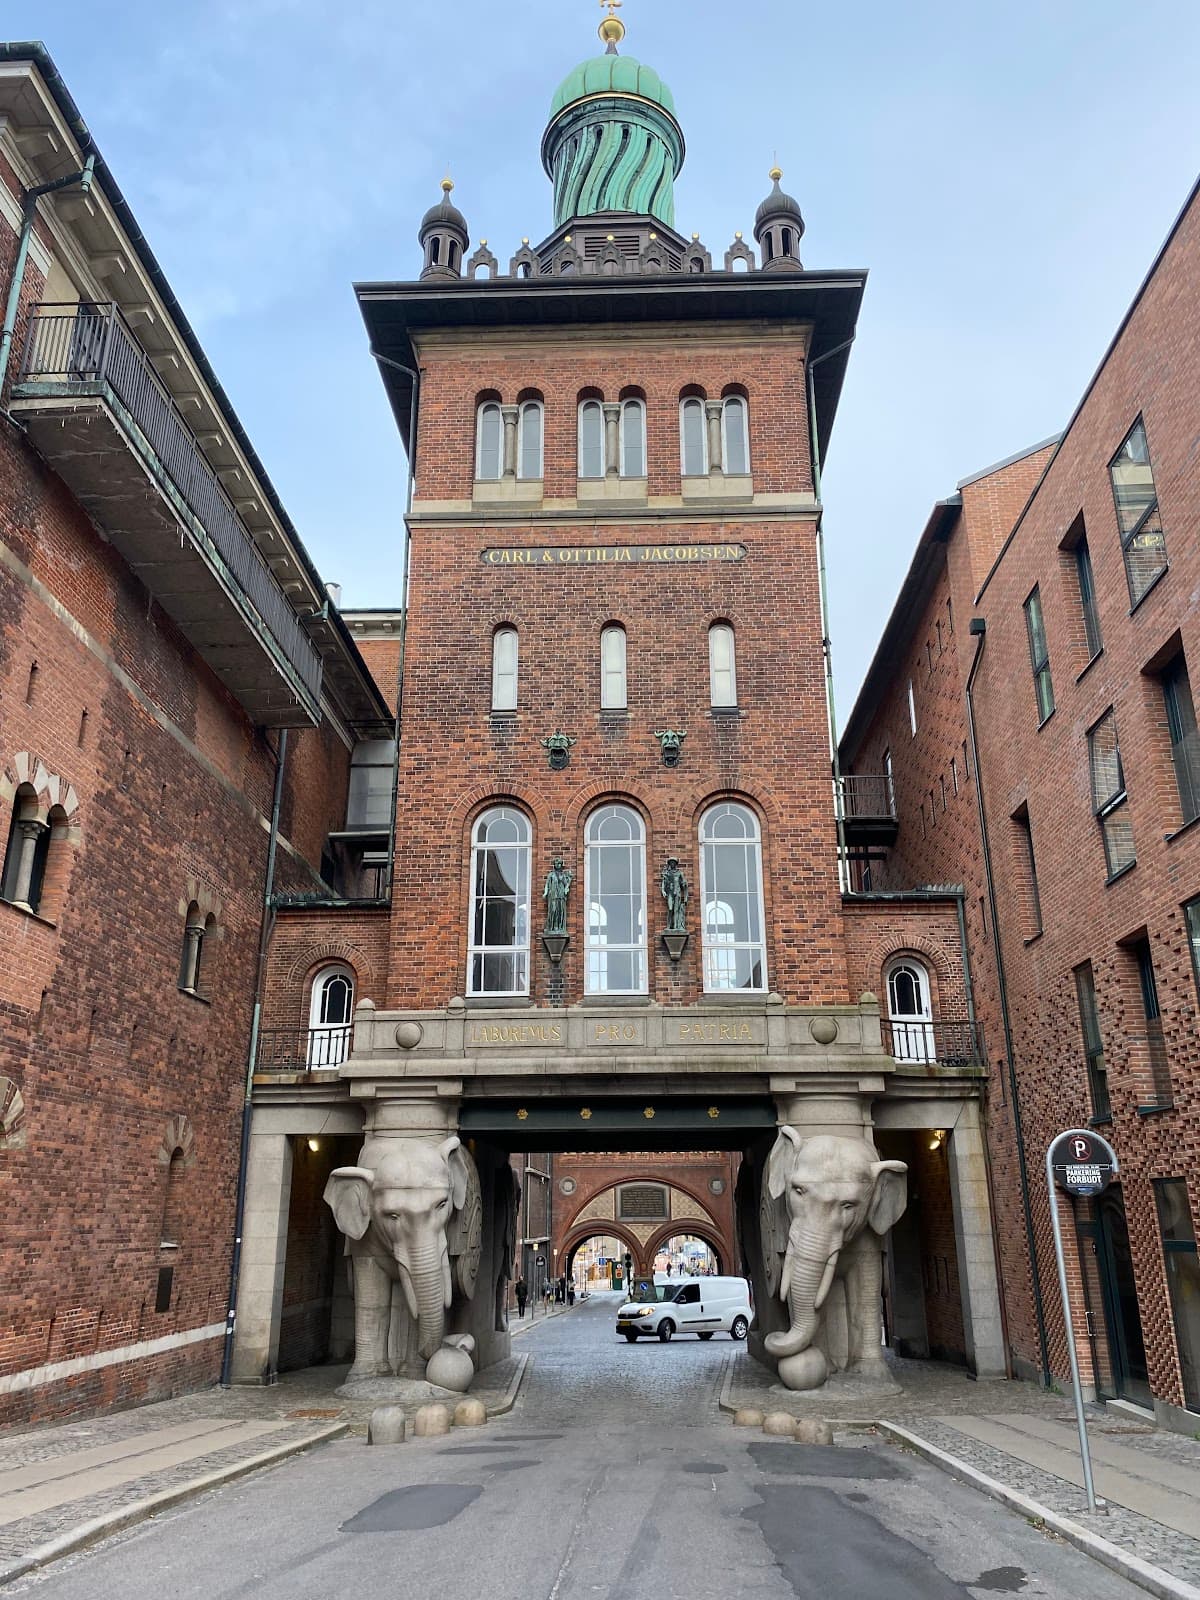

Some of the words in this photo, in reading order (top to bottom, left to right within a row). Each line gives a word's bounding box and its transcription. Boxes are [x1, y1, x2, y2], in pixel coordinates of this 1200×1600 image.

[488, 550, 537, 563] CARL
[542, 550, 554, 562] &
[559, 549, 632, 562] OTTILIA
[641, 546, 740, 561] JACOBSEN
[471, 1024, 561, 1042] LABOREMUS
[594, 1023, 638, 1041] PRO
[680, 1023, 753, 1041] PATRIA
[1066, 1175, 1102, 1184] FORBUDT
